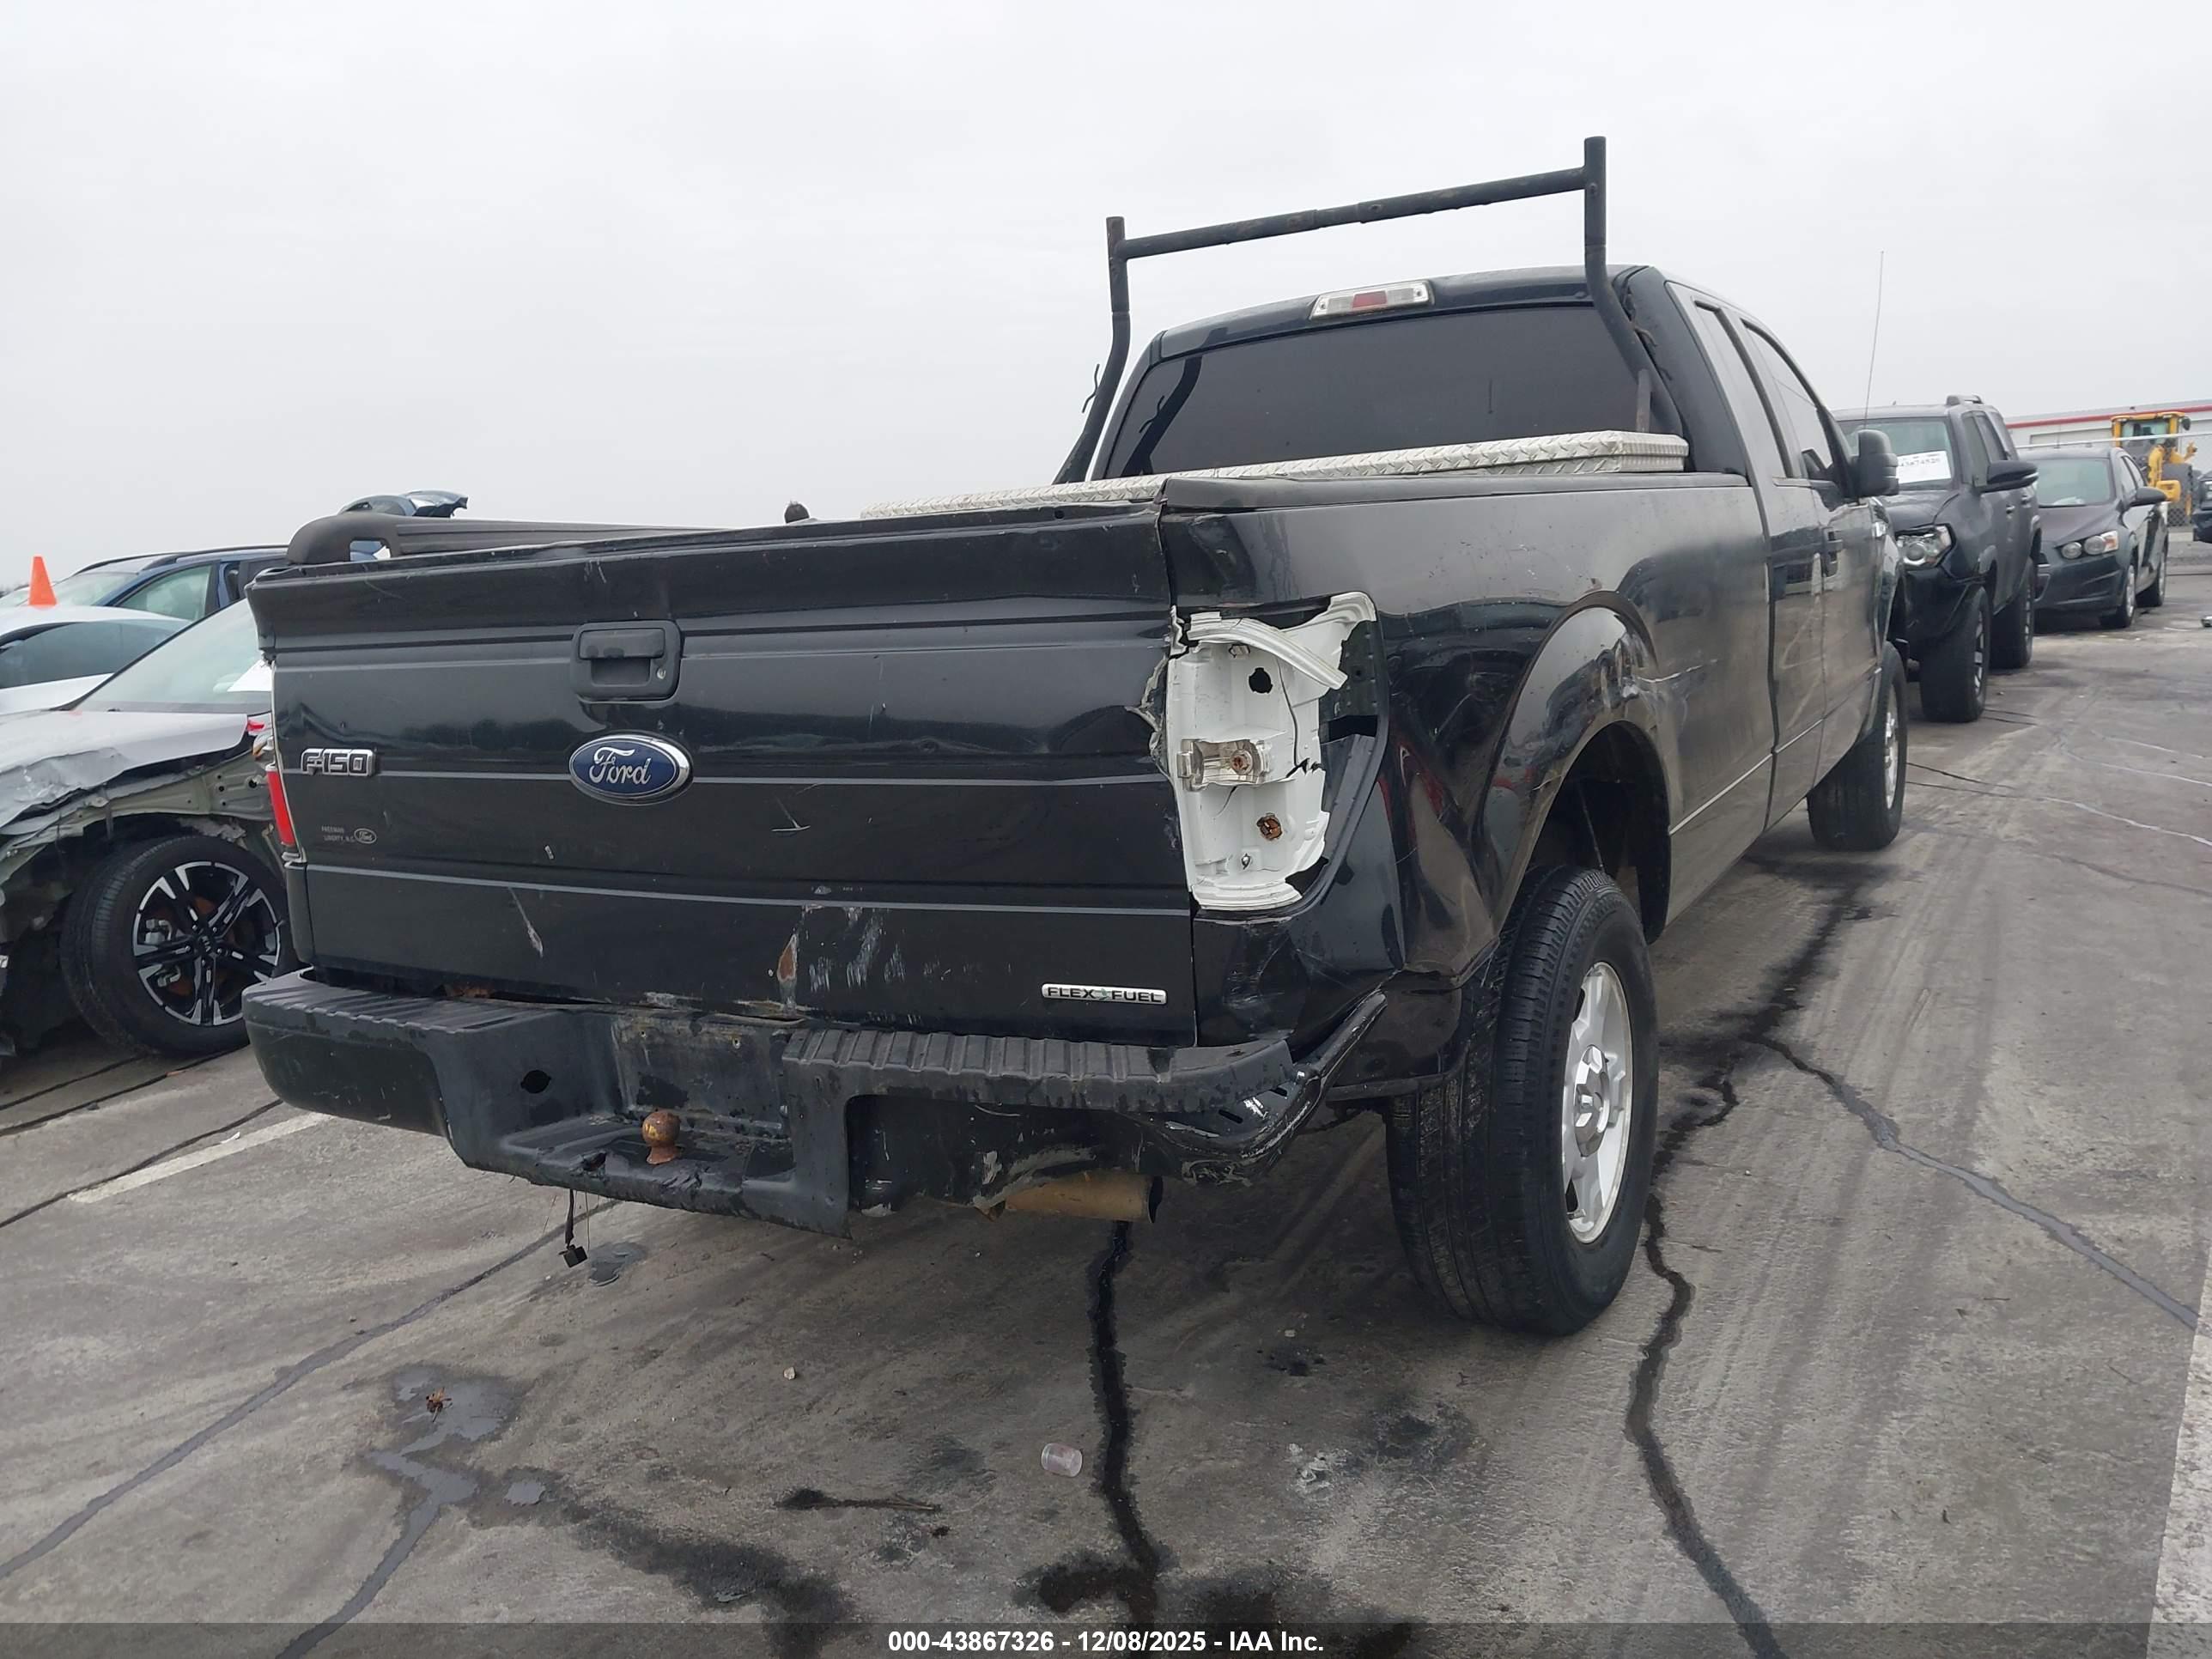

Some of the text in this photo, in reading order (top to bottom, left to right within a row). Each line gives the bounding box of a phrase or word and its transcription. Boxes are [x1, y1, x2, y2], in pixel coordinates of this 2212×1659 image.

[589, 746, 651, 785] Ford
[1048, 987, 1162, 1002] FLEX FUEL
